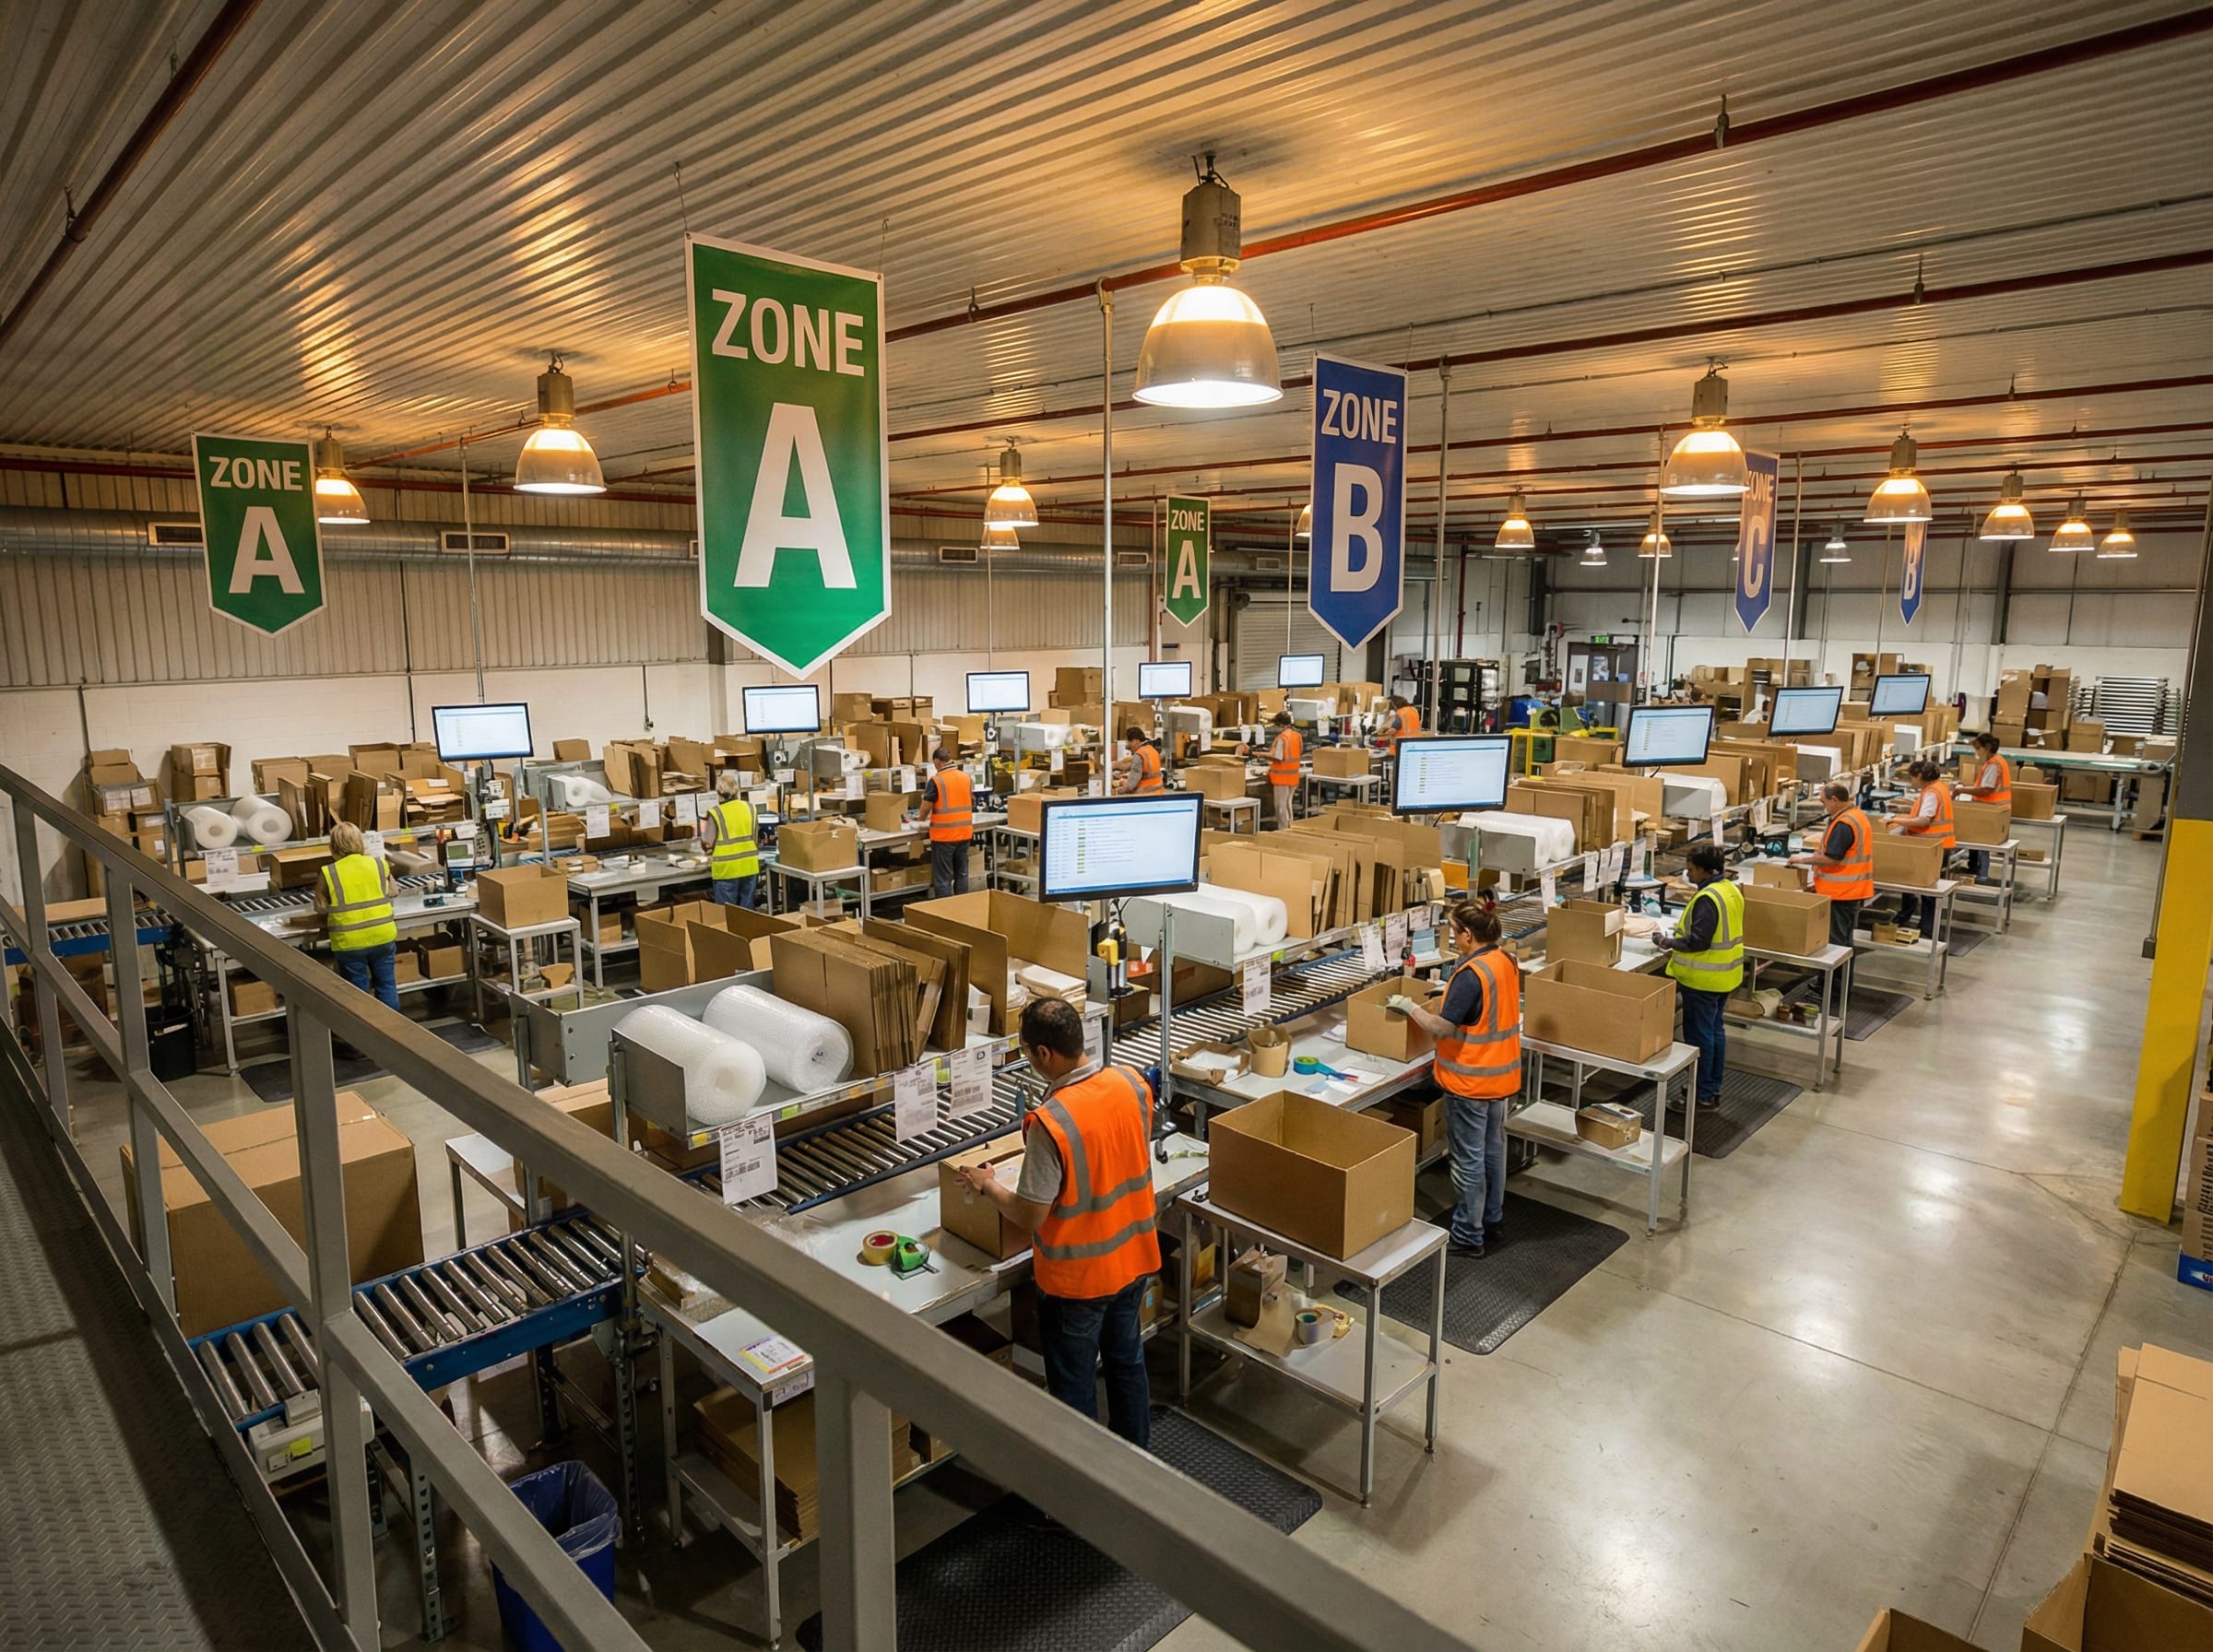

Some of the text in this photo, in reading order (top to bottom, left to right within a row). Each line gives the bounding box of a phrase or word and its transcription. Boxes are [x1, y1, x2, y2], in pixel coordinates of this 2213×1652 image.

[712, 289, 865, 377] ZONE
[1320, 388, 1398, 444] ZONE
[208, 455, 303, 491] ZONE
[733, 402, 858, 589] A
[228, 506, 305, 594] A
[1170, 509, 1205, 532] ZONE
[1330, 462, 1383, 593] B
[1744, 514, 1766, 599] C
[1171, 539, 1201, 599] A
